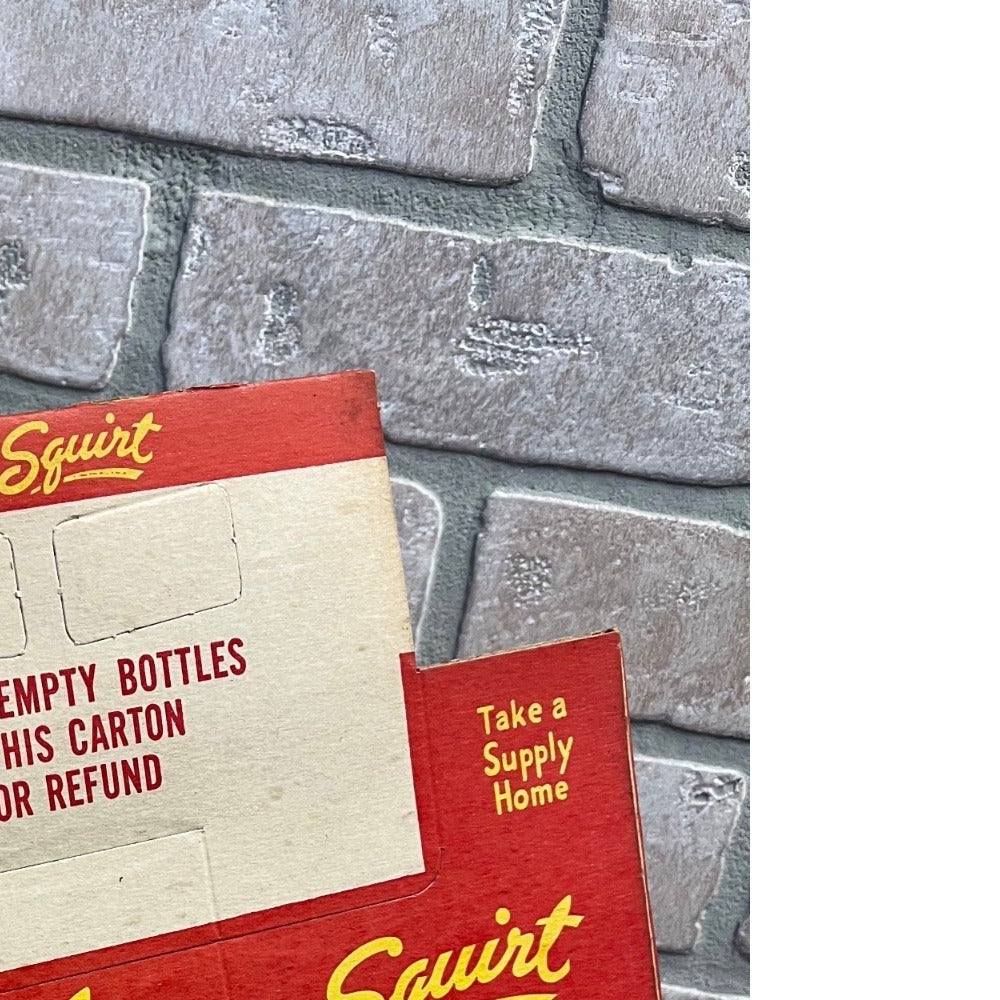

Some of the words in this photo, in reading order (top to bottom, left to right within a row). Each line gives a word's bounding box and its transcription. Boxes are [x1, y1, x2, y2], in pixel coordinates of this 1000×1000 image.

[116, 637, 247, 697] BOTTLES
[67, 698, 186, 757] CARTON
[476, 699, 542, 734] Take
[552, 697, 568, 719] a
[45, 753, 163, 812] REFUND
[484, 731, 573, 781] Supply
[493, 779, 569, 815] Home
